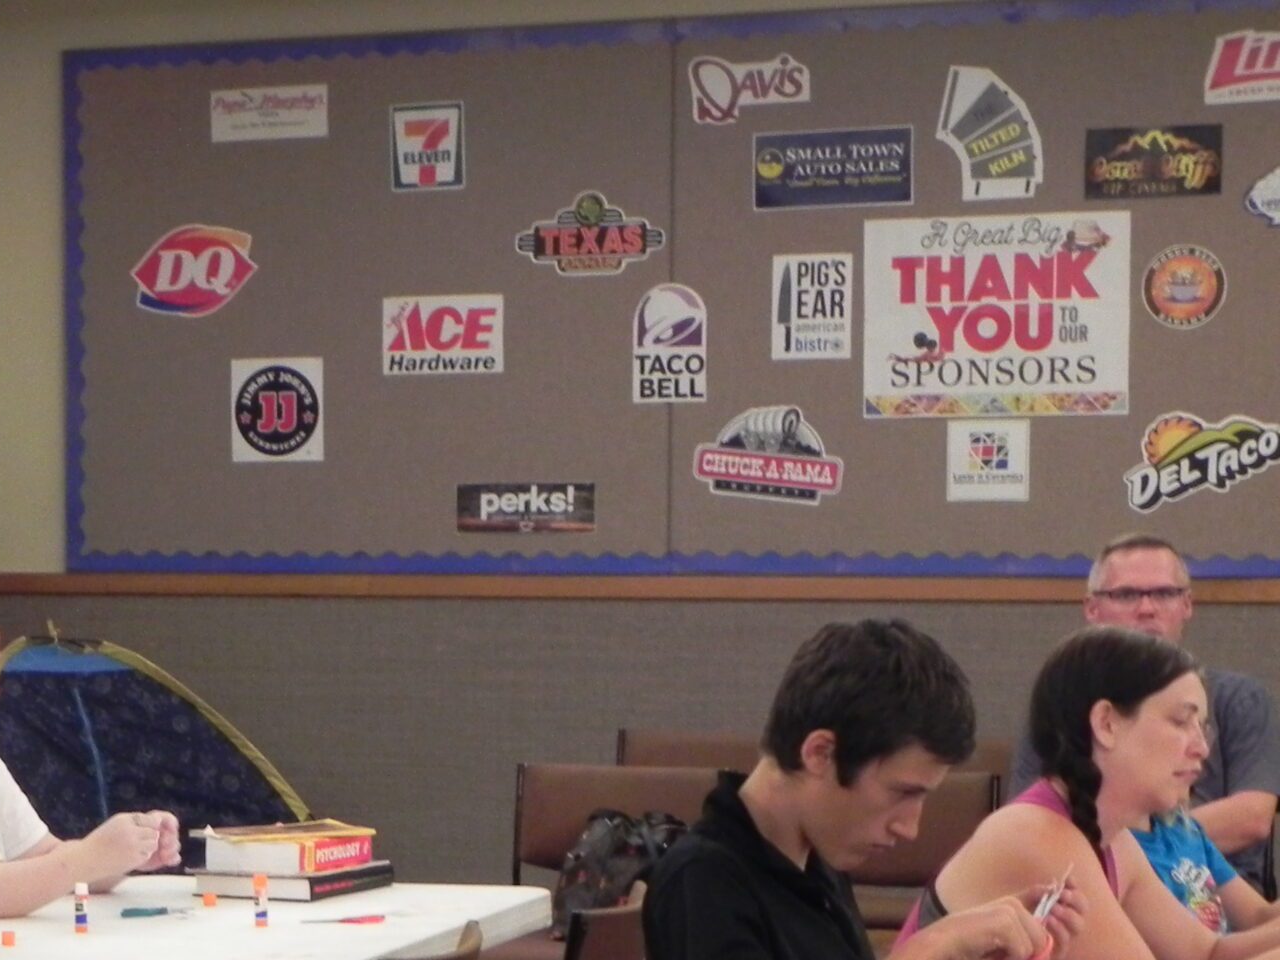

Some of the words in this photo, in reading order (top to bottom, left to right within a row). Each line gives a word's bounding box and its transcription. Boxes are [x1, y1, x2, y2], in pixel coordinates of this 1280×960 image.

[404, 118, 450, 187] 7
[785, 146, 847, 163] SMALL
[849, 142, 905, 160] TOWN
[970, 122, 1021, 156] TILTED
[793, 162, 842, 177] AUTO
[844, 160, 901, 175] SALES
[987, 149, 1027, 176] KILN
[539, 225, 643, 257] TEXAS
[920, 219, 948, 249] A
[953, 221, 1015, 254] Great
[1018, 217, 1061, 257] Big
[154, 246, 235, 295] DQ
[797, 260, 846, 287] PIG'S
[891, 250, 1101, 304] THANK
[797, 289, 845, 319] EAR
[1060, 306, 1079, 323] TO
[388, 301, 497, 352] ACE
[795, 322, 846, 333] american
[926, 303, 1054, 353] YOU
[1059, 325, 1088, 343] OUR
[389, 354, 496, 372] Hardware
[635, 354, 704, 375] TACO
[890, 355, 1098, 388] SPONSORS
[241, 370, 275, 406] JIMMY
[639, 378, 704, 398] BELL
[257, 391, 298, 433] JJ
[1127, 456, 1202, 506] DEL
[1195, 431, 1279, 485] TACO
[480, 485, 575, 521] perks!
